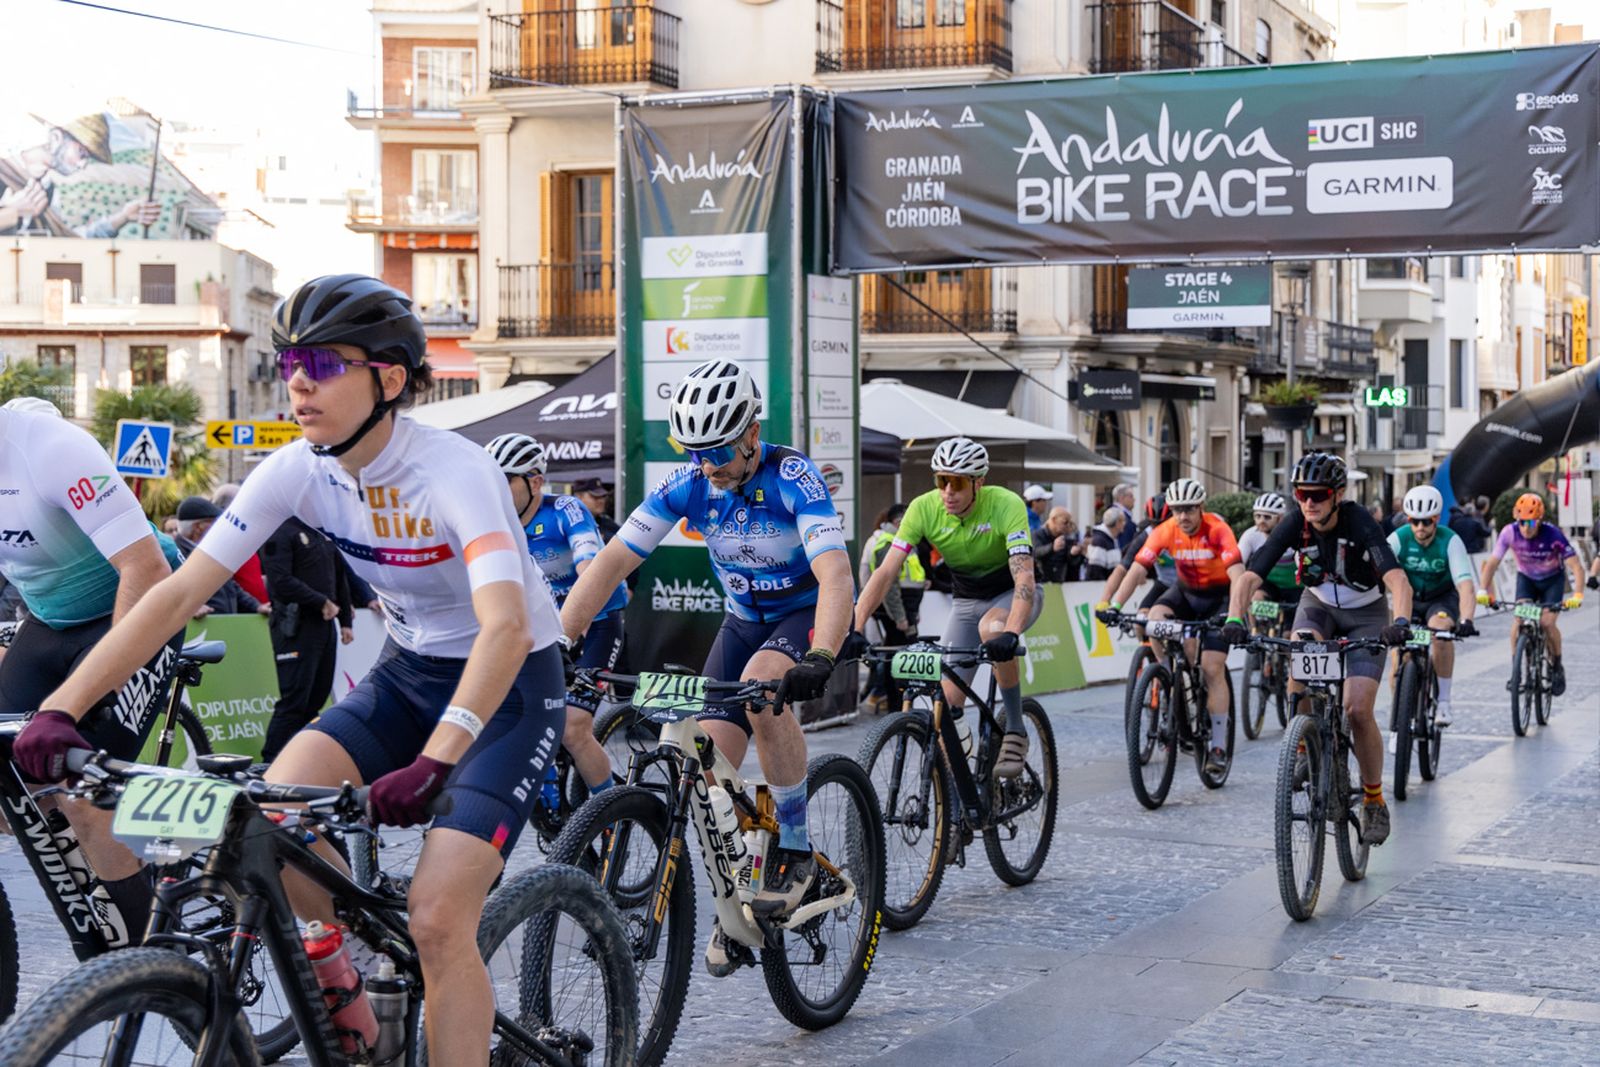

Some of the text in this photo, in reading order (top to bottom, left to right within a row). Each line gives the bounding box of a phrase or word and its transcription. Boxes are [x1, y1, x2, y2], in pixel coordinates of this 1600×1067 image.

[865, 108, 942, 132] Andalucía
[1013, 98, 1292, 175] Andalucía
[1319, 121, 1418, 143] UCI SHC
[651, 149, 762, 185] Andalucía
[885, 155, 962, 178] GRANADA
[902, 180, 945, 203] JAÉN
[1016, 173, 1130, 224] BIKE
[1145, 166, 1294, 219] RACE
[1324, 174, 1437, 196] GARMIN
[885, 204, 962, 228] CÓRDOBA
[1164, 271, 1232, 287] STAGE 4
[1177, 289, 1220, 304] JAÉN
[1173, 312, 1225, 322] GARMIN
[1366, 387, 1407, 406] LAS
[381, 550, 439, 563] TREK
[652, 577, 720, 599] Andalucía
[751, 577, 793, 591] SDLE
[652, 596, 722, 612] BIKE RACE
[1153, 622, 1174, 637] 883
[1413, 631, 1426, 641] 03
[607, 637, 622, 670] SDLE
[899, 653, 935, 676] 2208
[1302, 655, 1329, 675] 817
[644, 673, 699, 702] 2210
[204, 721, 265, 742] DE JAÉN
[512, 777, 536, 803] Dr.
[529, 726, 556, 771] bike
[131, 776, 228, 825] 2215
[694, 773, 735, 899] ORBEA
[863, 910, 881, 972] MAXXIS
